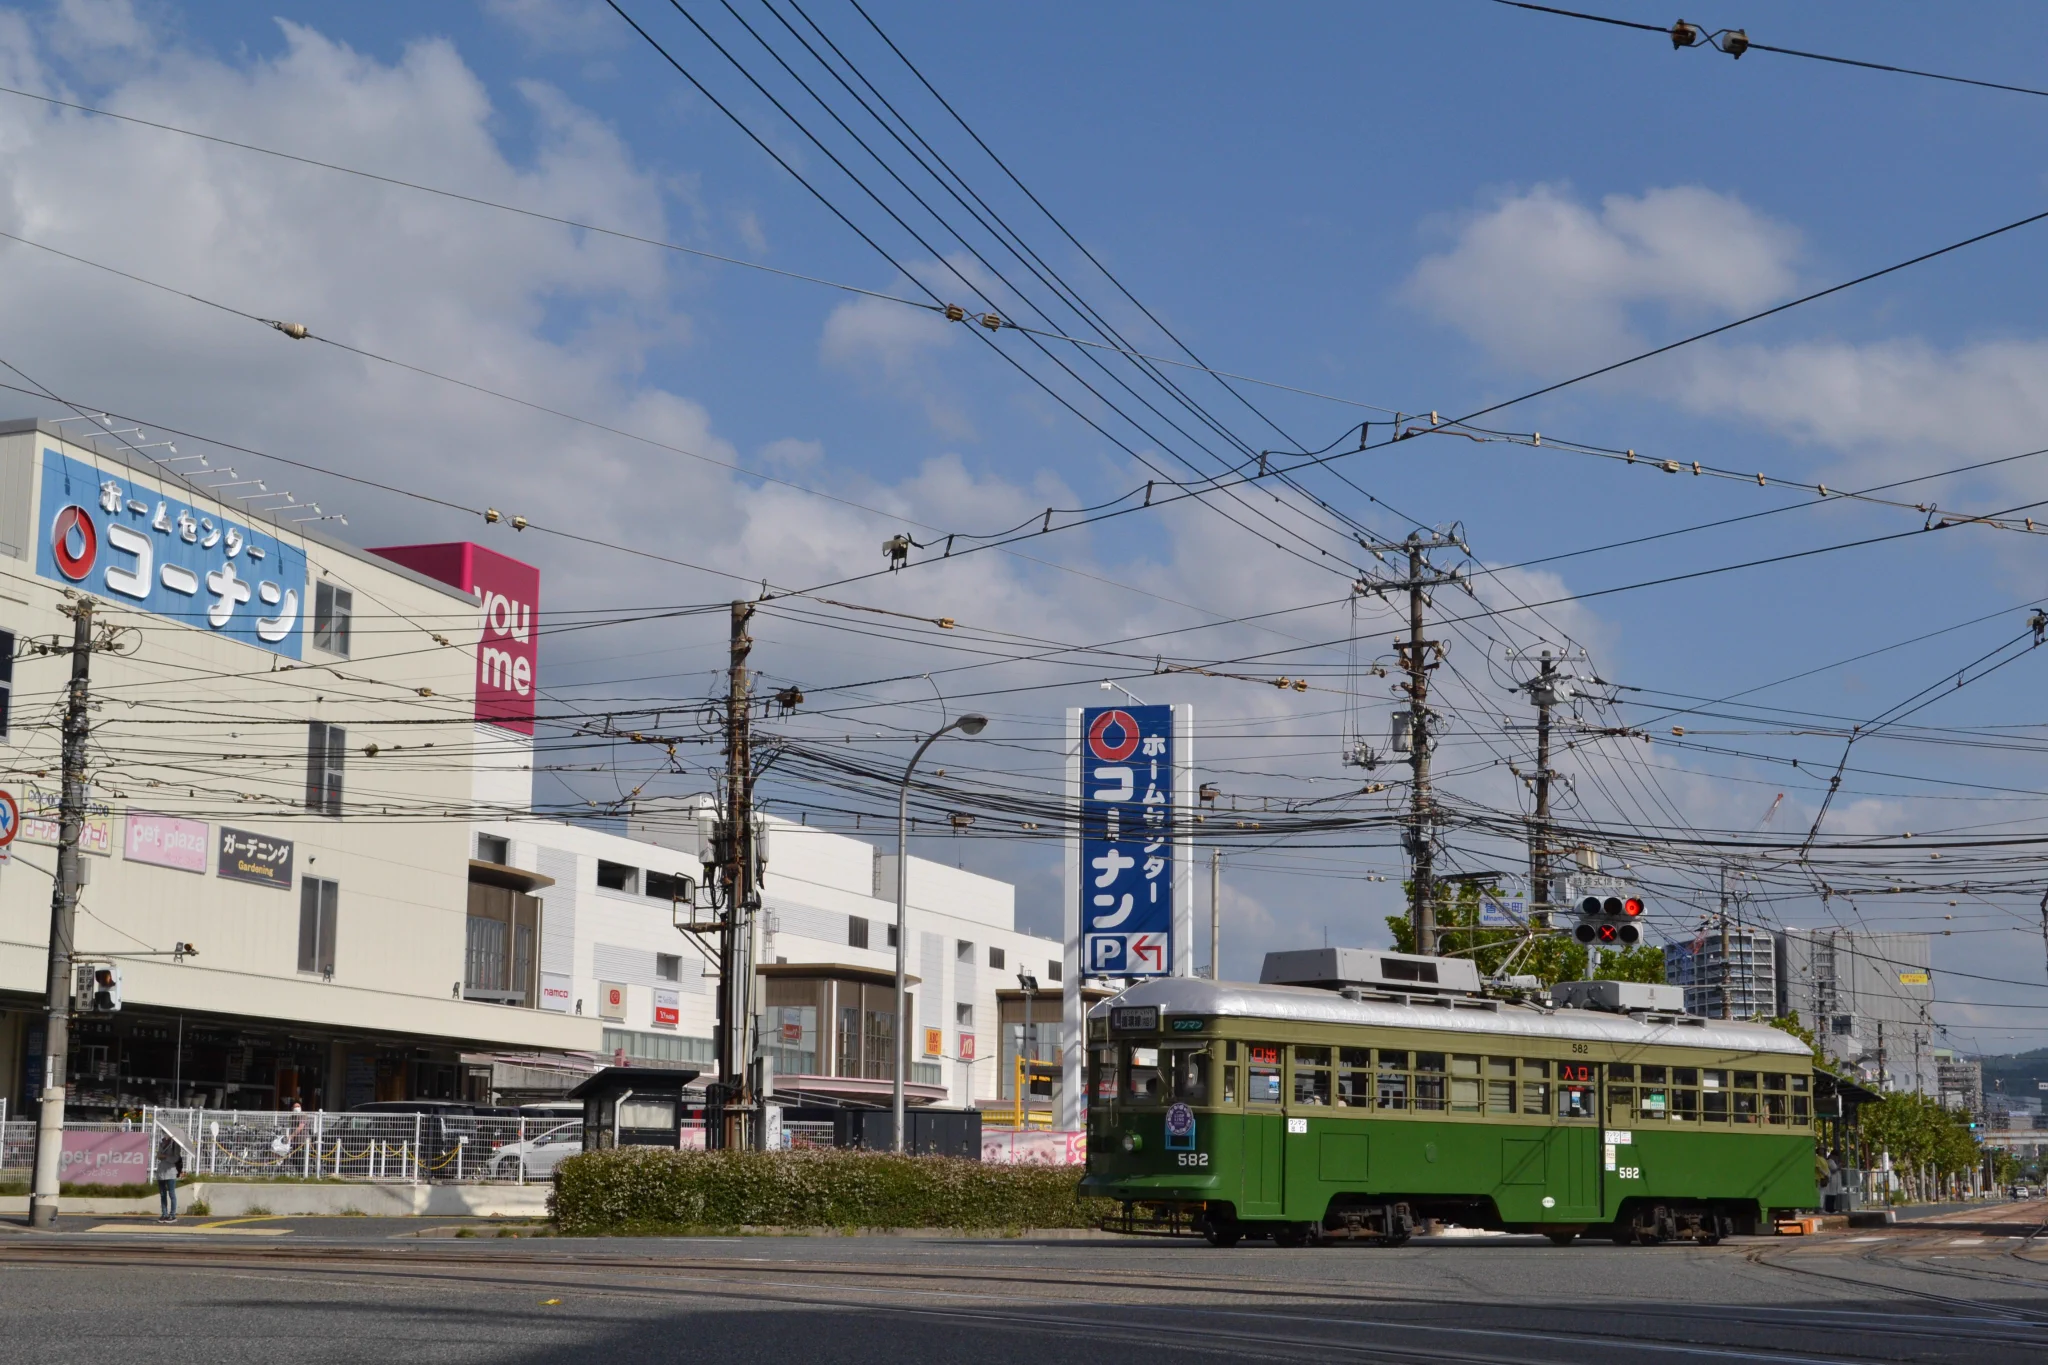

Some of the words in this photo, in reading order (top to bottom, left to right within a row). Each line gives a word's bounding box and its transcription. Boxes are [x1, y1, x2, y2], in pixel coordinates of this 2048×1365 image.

[100, 479, 266, 559] ホームセンター
[104, 522, 298, 642] コーナン
[473, 585, 530, 645] you
[481, 646, 531, 696] me
[1142, 733, 1167, 904] ホームセンター
[132, 824, 161, 852] pet
[163, 830, 206, 853] plaza
[223, 834, 290, 864] ガーデニング
[1092, 766, 1135, 929] コーナン
[238, 860, 274, 878] Gardening
[1096, 939, 1122, 969] P
[543, 988, 569, 998] namco
[1173, 1020, 1203, 1029] ワンマン
[1572, 1044, 1588, 1054] 582
[1563, 1066, 1588, 1081] 入口
[96, 1150, 144, 1168] plaza
[1178, 1153, 1208, 1166] 582
[1619, 1167, 1639, 1179] 582
